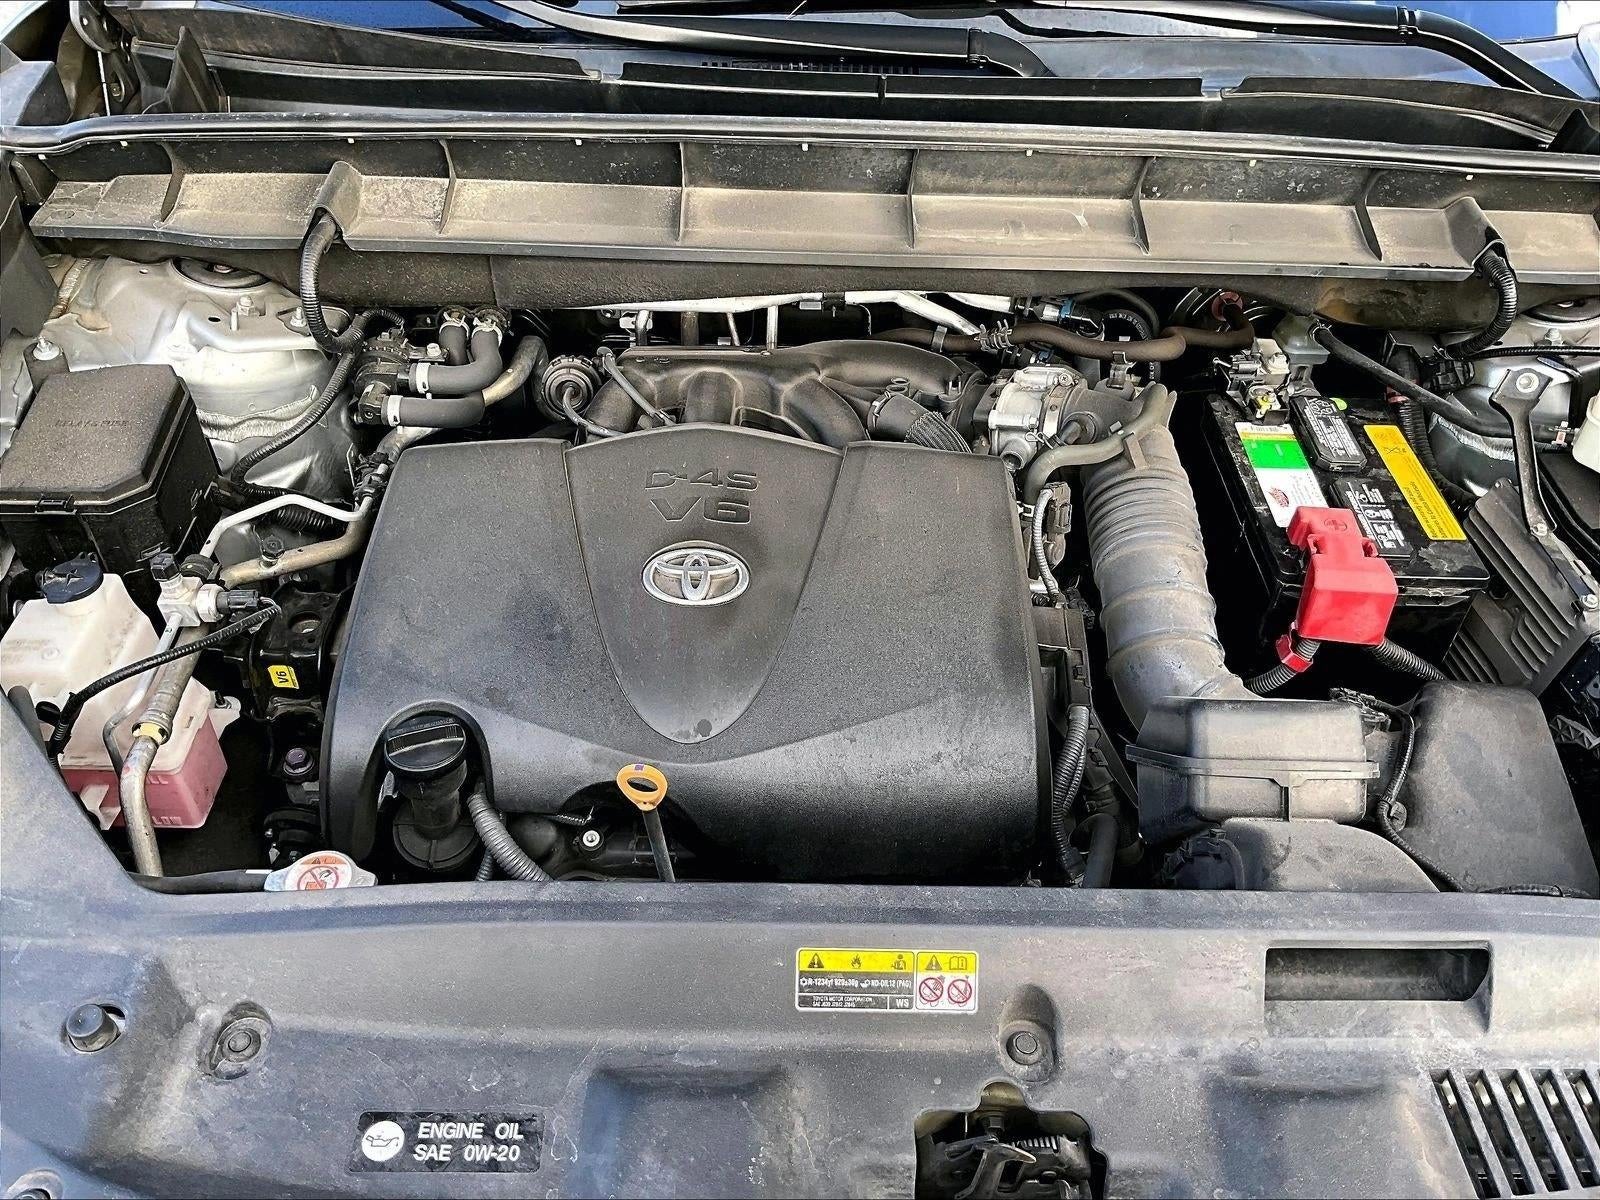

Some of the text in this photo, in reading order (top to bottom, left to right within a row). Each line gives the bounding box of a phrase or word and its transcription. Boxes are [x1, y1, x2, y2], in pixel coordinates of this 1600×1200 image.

[644, 468, 759, 492] D-4S
[650, 496, 752, 525] V6
[276, 671, 289, 683] V6
[895, 998, 910, 1008] WS
[417, 1122, 524, 1140] ENGINE OIL
[412, 1144, 521, 1162] SAE 0W-20
